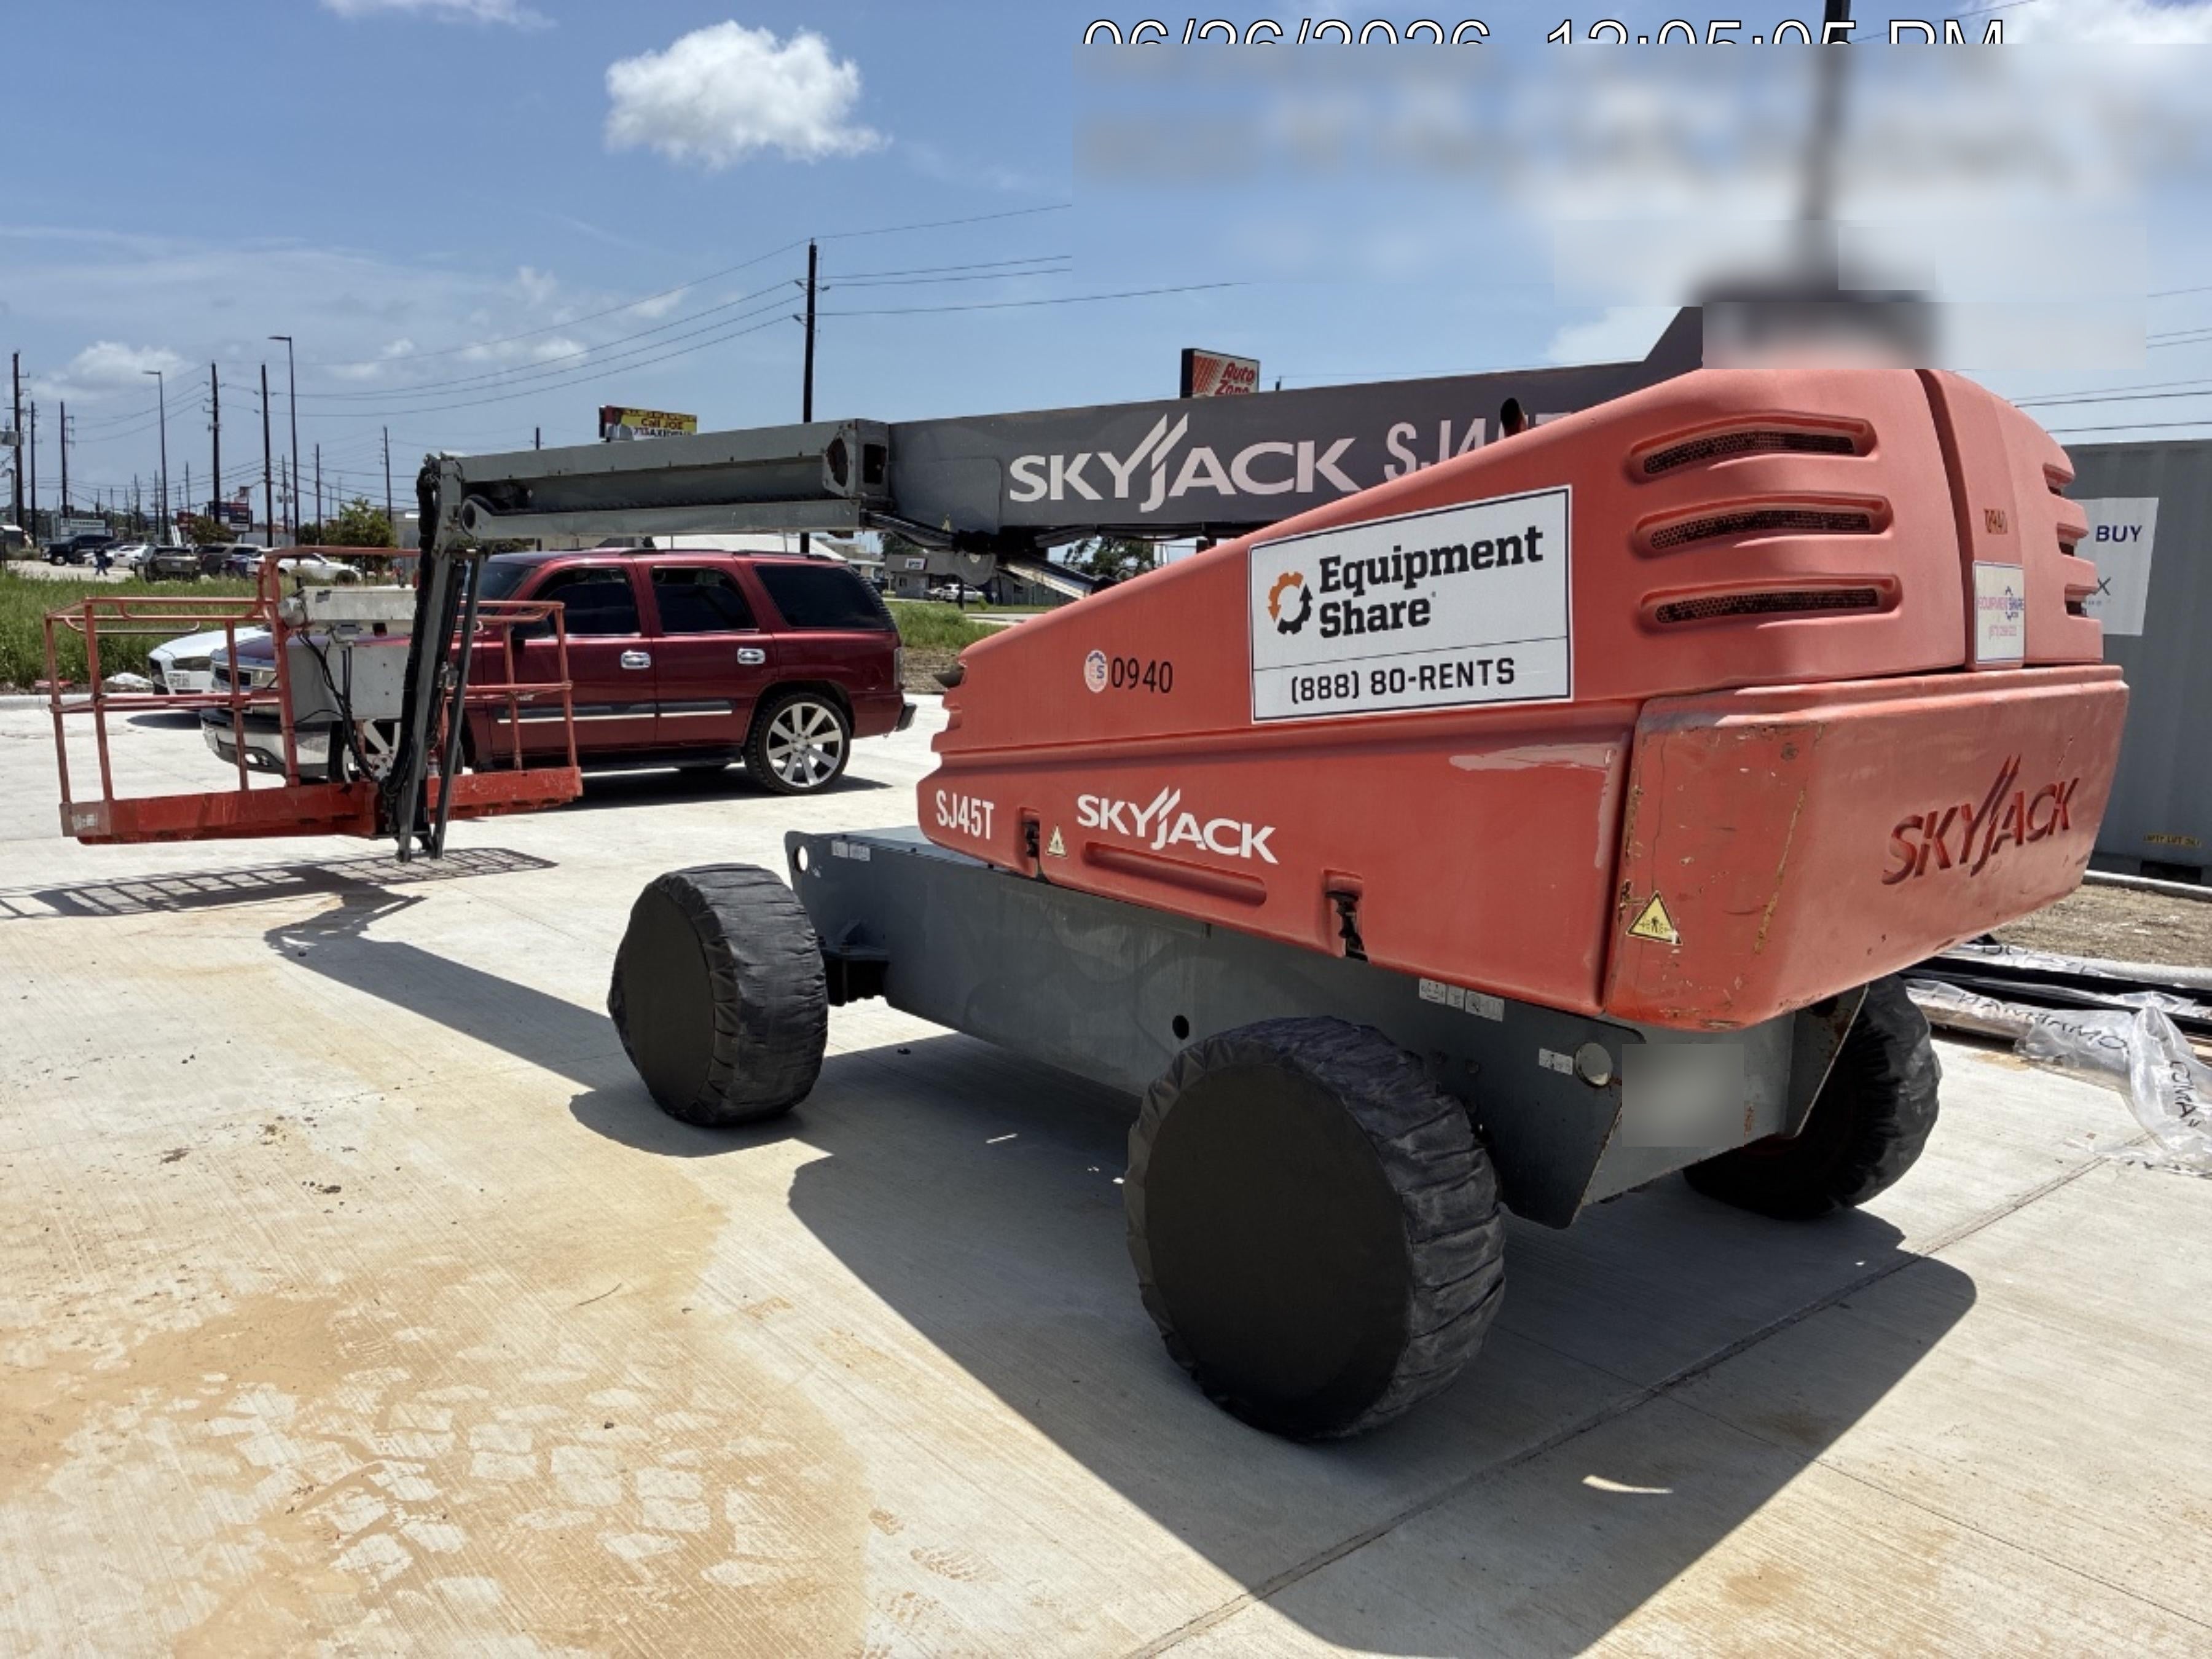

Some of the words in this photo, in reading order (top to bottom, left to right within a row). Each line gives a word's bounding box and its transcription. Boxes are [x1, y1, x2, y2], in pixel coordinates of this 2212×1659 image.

[1222, 360, 1255, 383] Auto
[1009, 412, 1363, 512] SKYJACK
[2095, 525, 2143, 543] BUY
[1319, 525, 1543, 597] Equipment
[1319, 597, 1430, 638] Share
[1111, 657, 1173, 694] 0940
[1291, 670, 1360, 704] (888)
[1370, 657, 1515, 695] 80-RENTS
[936, 790, 994, 840] SJ45T
[1077, 785, 1279, 864] SKYJACK
[1881, 754, 2080, 885] SKYJACK
